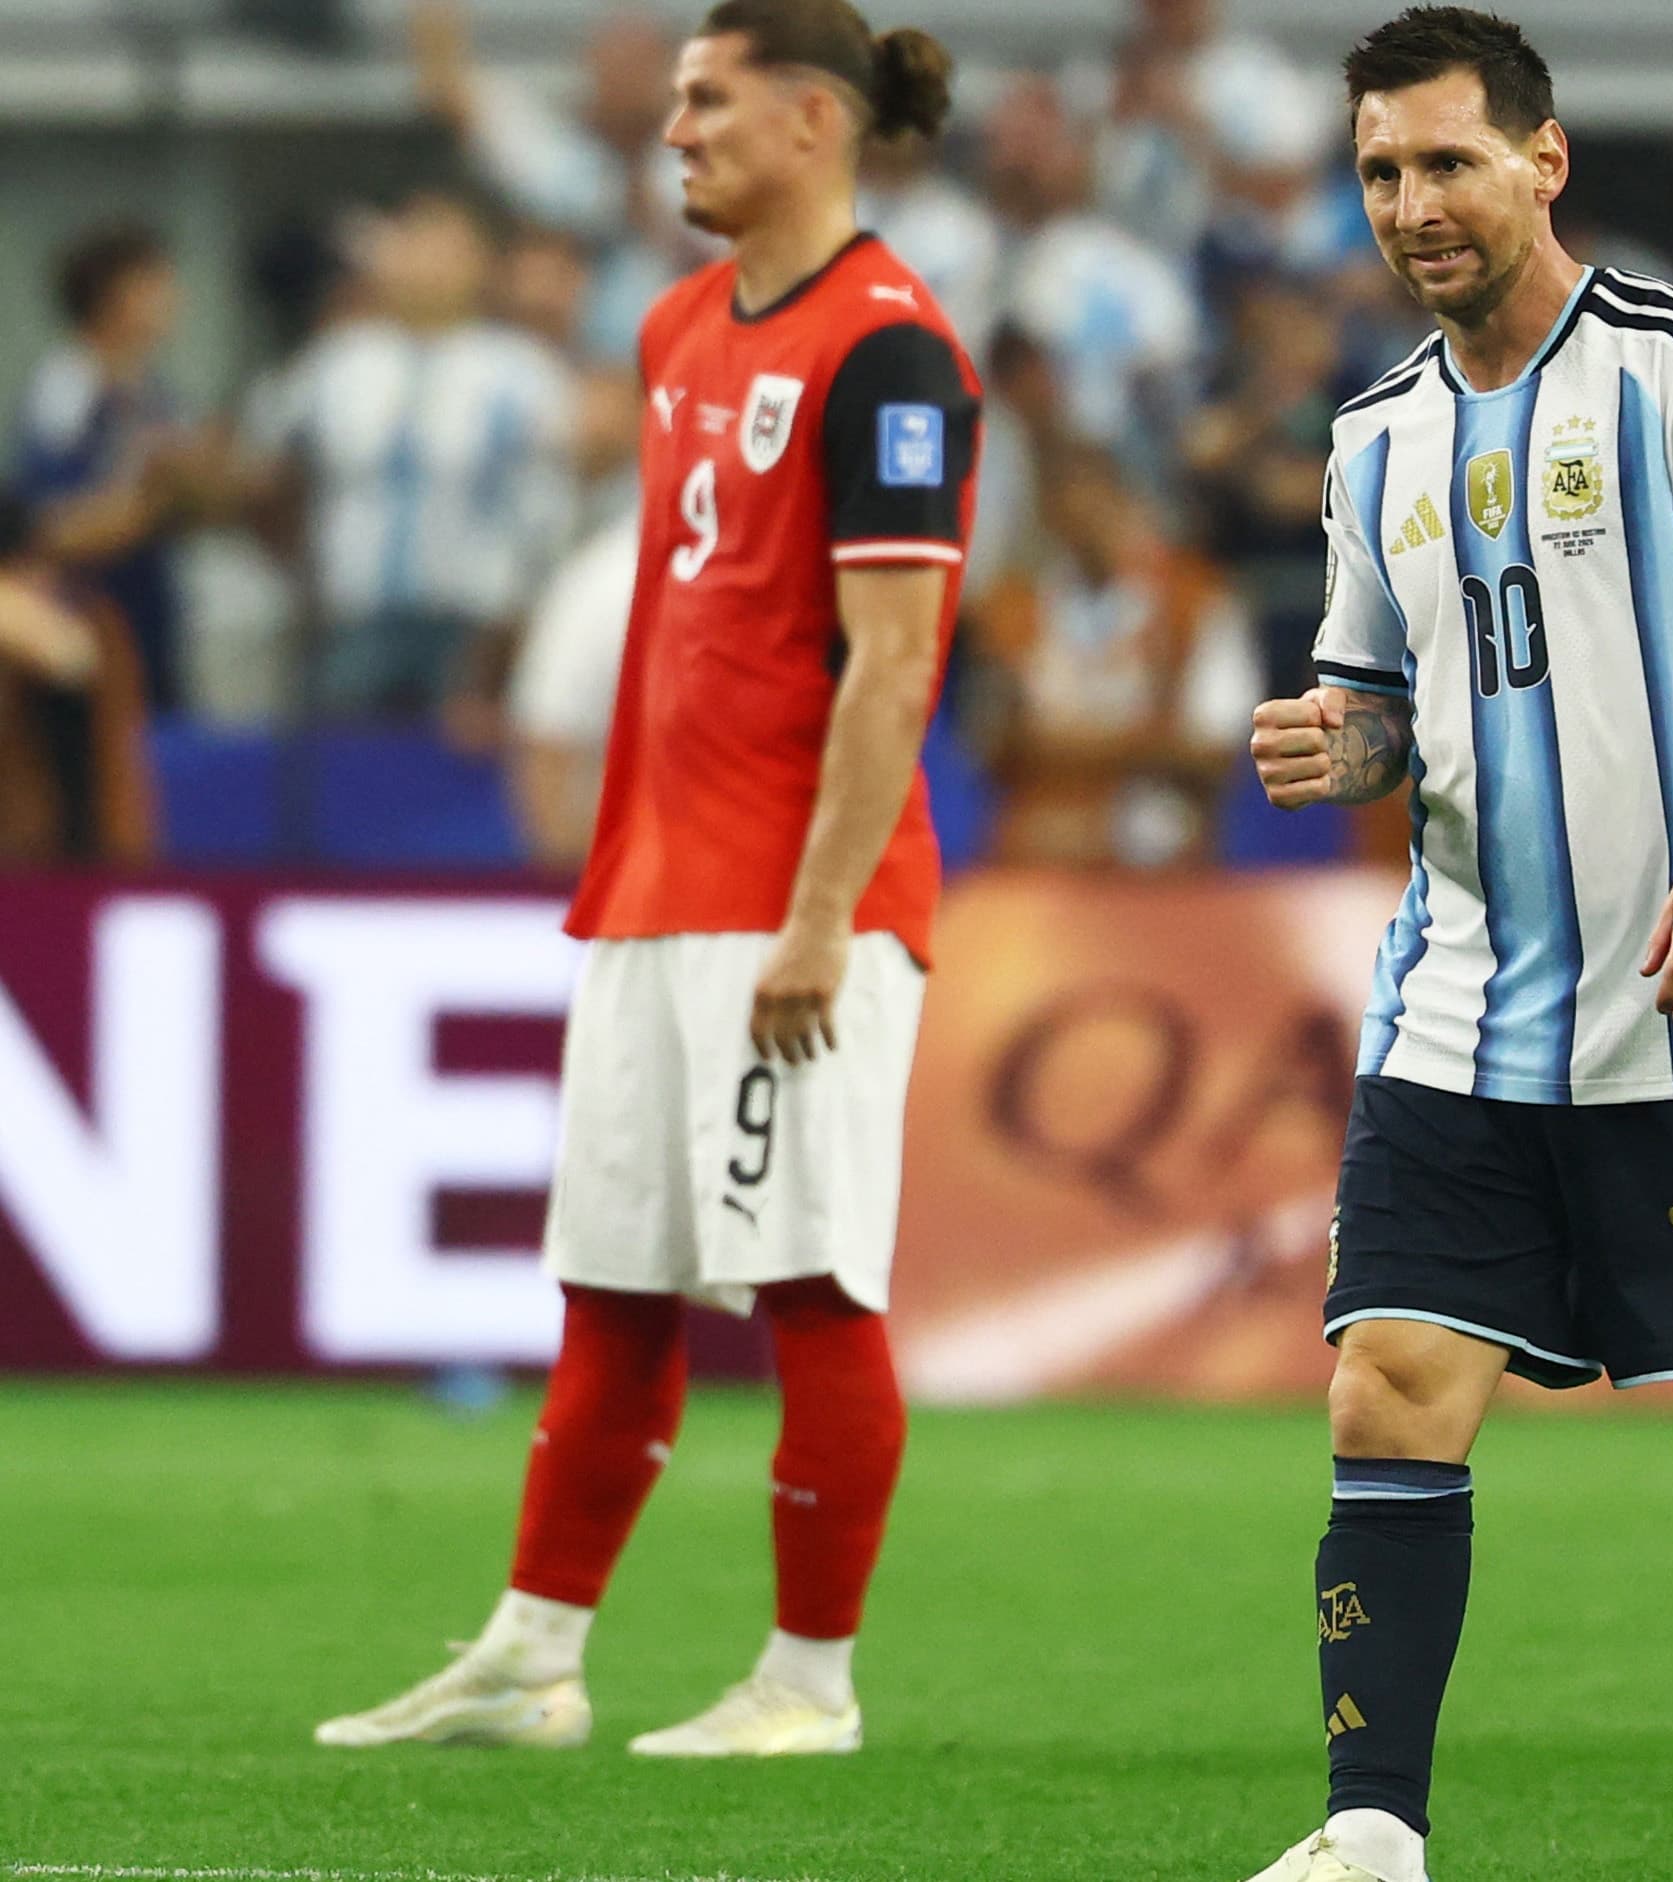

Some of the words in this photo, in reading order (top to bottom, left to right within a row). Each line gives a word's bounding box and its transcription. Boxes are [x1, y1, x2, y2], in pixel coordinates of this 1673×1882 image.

[671, 458, 719, 582] 9
[1552, 459, 1590, 497] AFA
[1460, 563, 1551, 699] 10
[729, 1064, 775, 1185] 9
